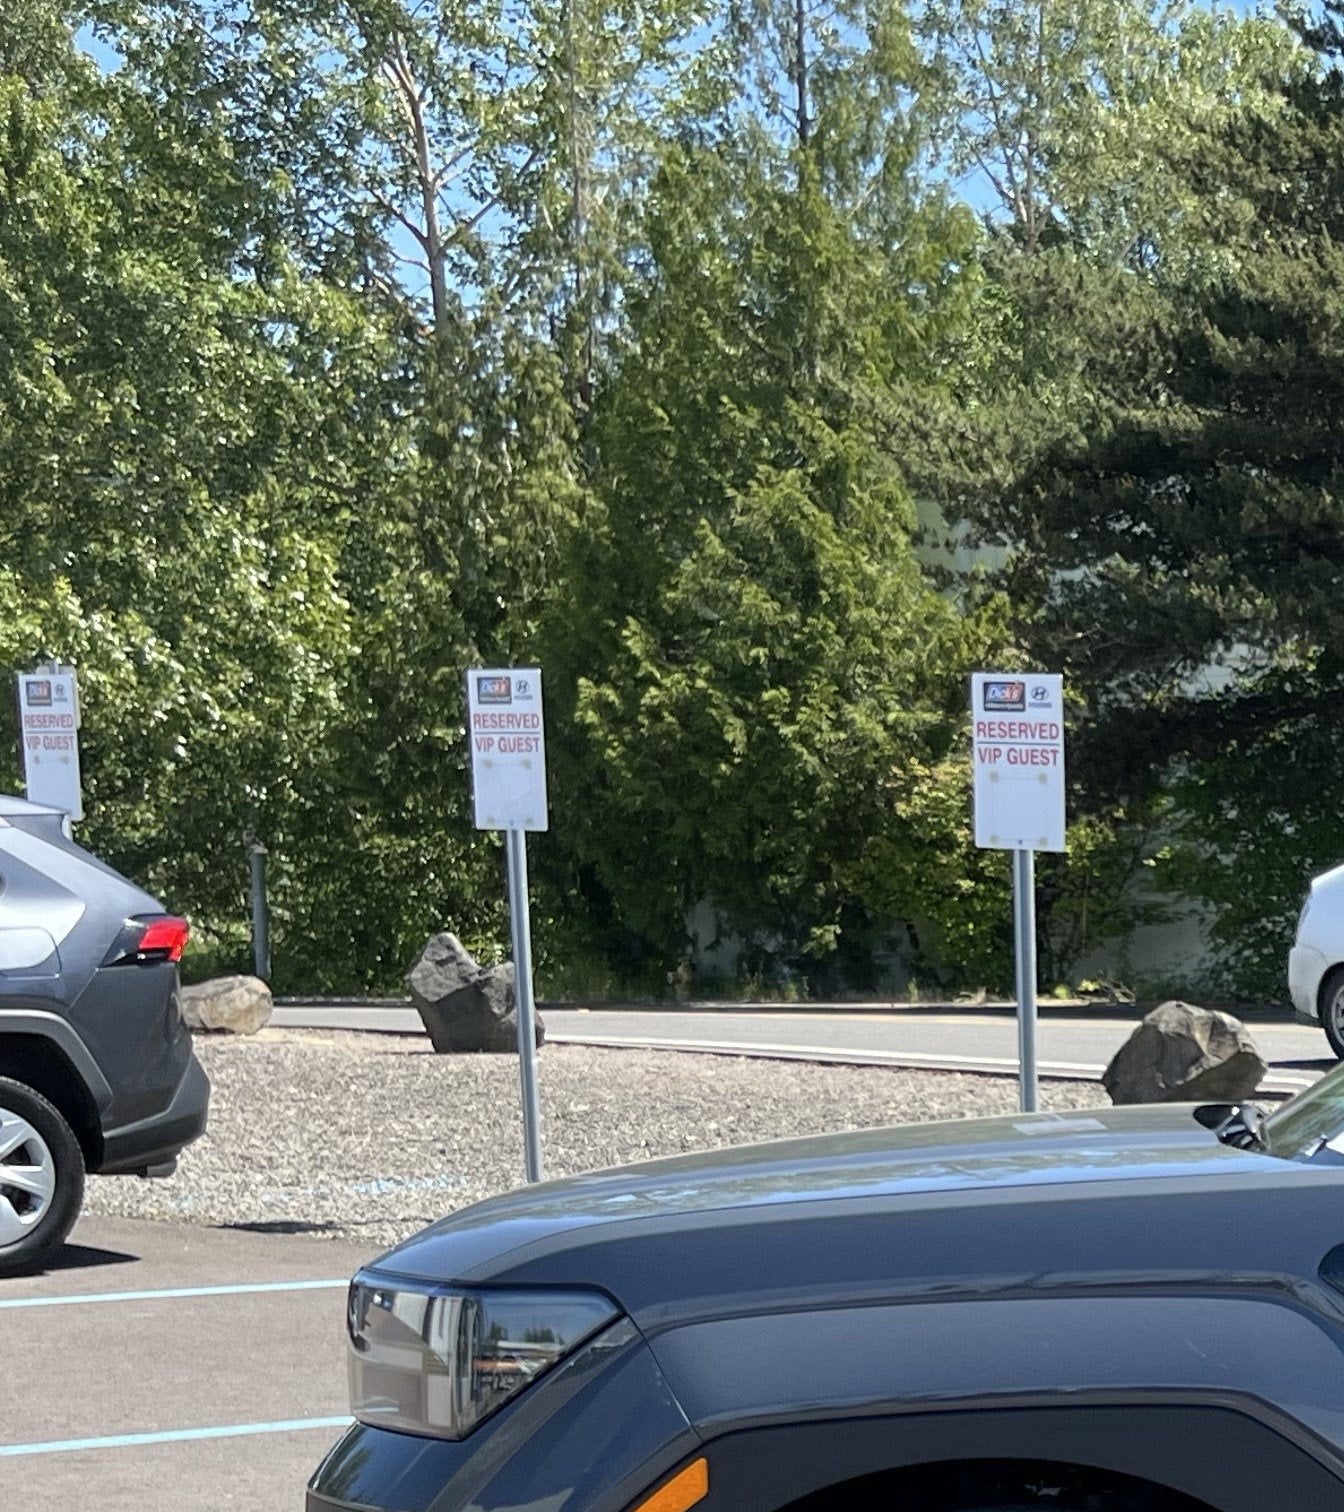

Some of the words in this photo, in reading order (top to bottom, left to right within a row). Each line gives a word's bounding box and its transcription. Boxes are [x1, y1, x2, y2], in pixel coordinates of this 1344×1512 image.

[24, 714, 73, 729] RESERVED
[473, 713, 539, 729] RESERVED
[976, 721, 1059, 740] RESERVED
[26, 736, 40, 750] VIP
[43, 736, 74, 750] GUEST
[475, 736, 494, 752] VIP
[498, 736, 540, 753] GUEST
[978, 747, 1002, 764] VIP
[1007, 747, 1060, 767] GUEST
